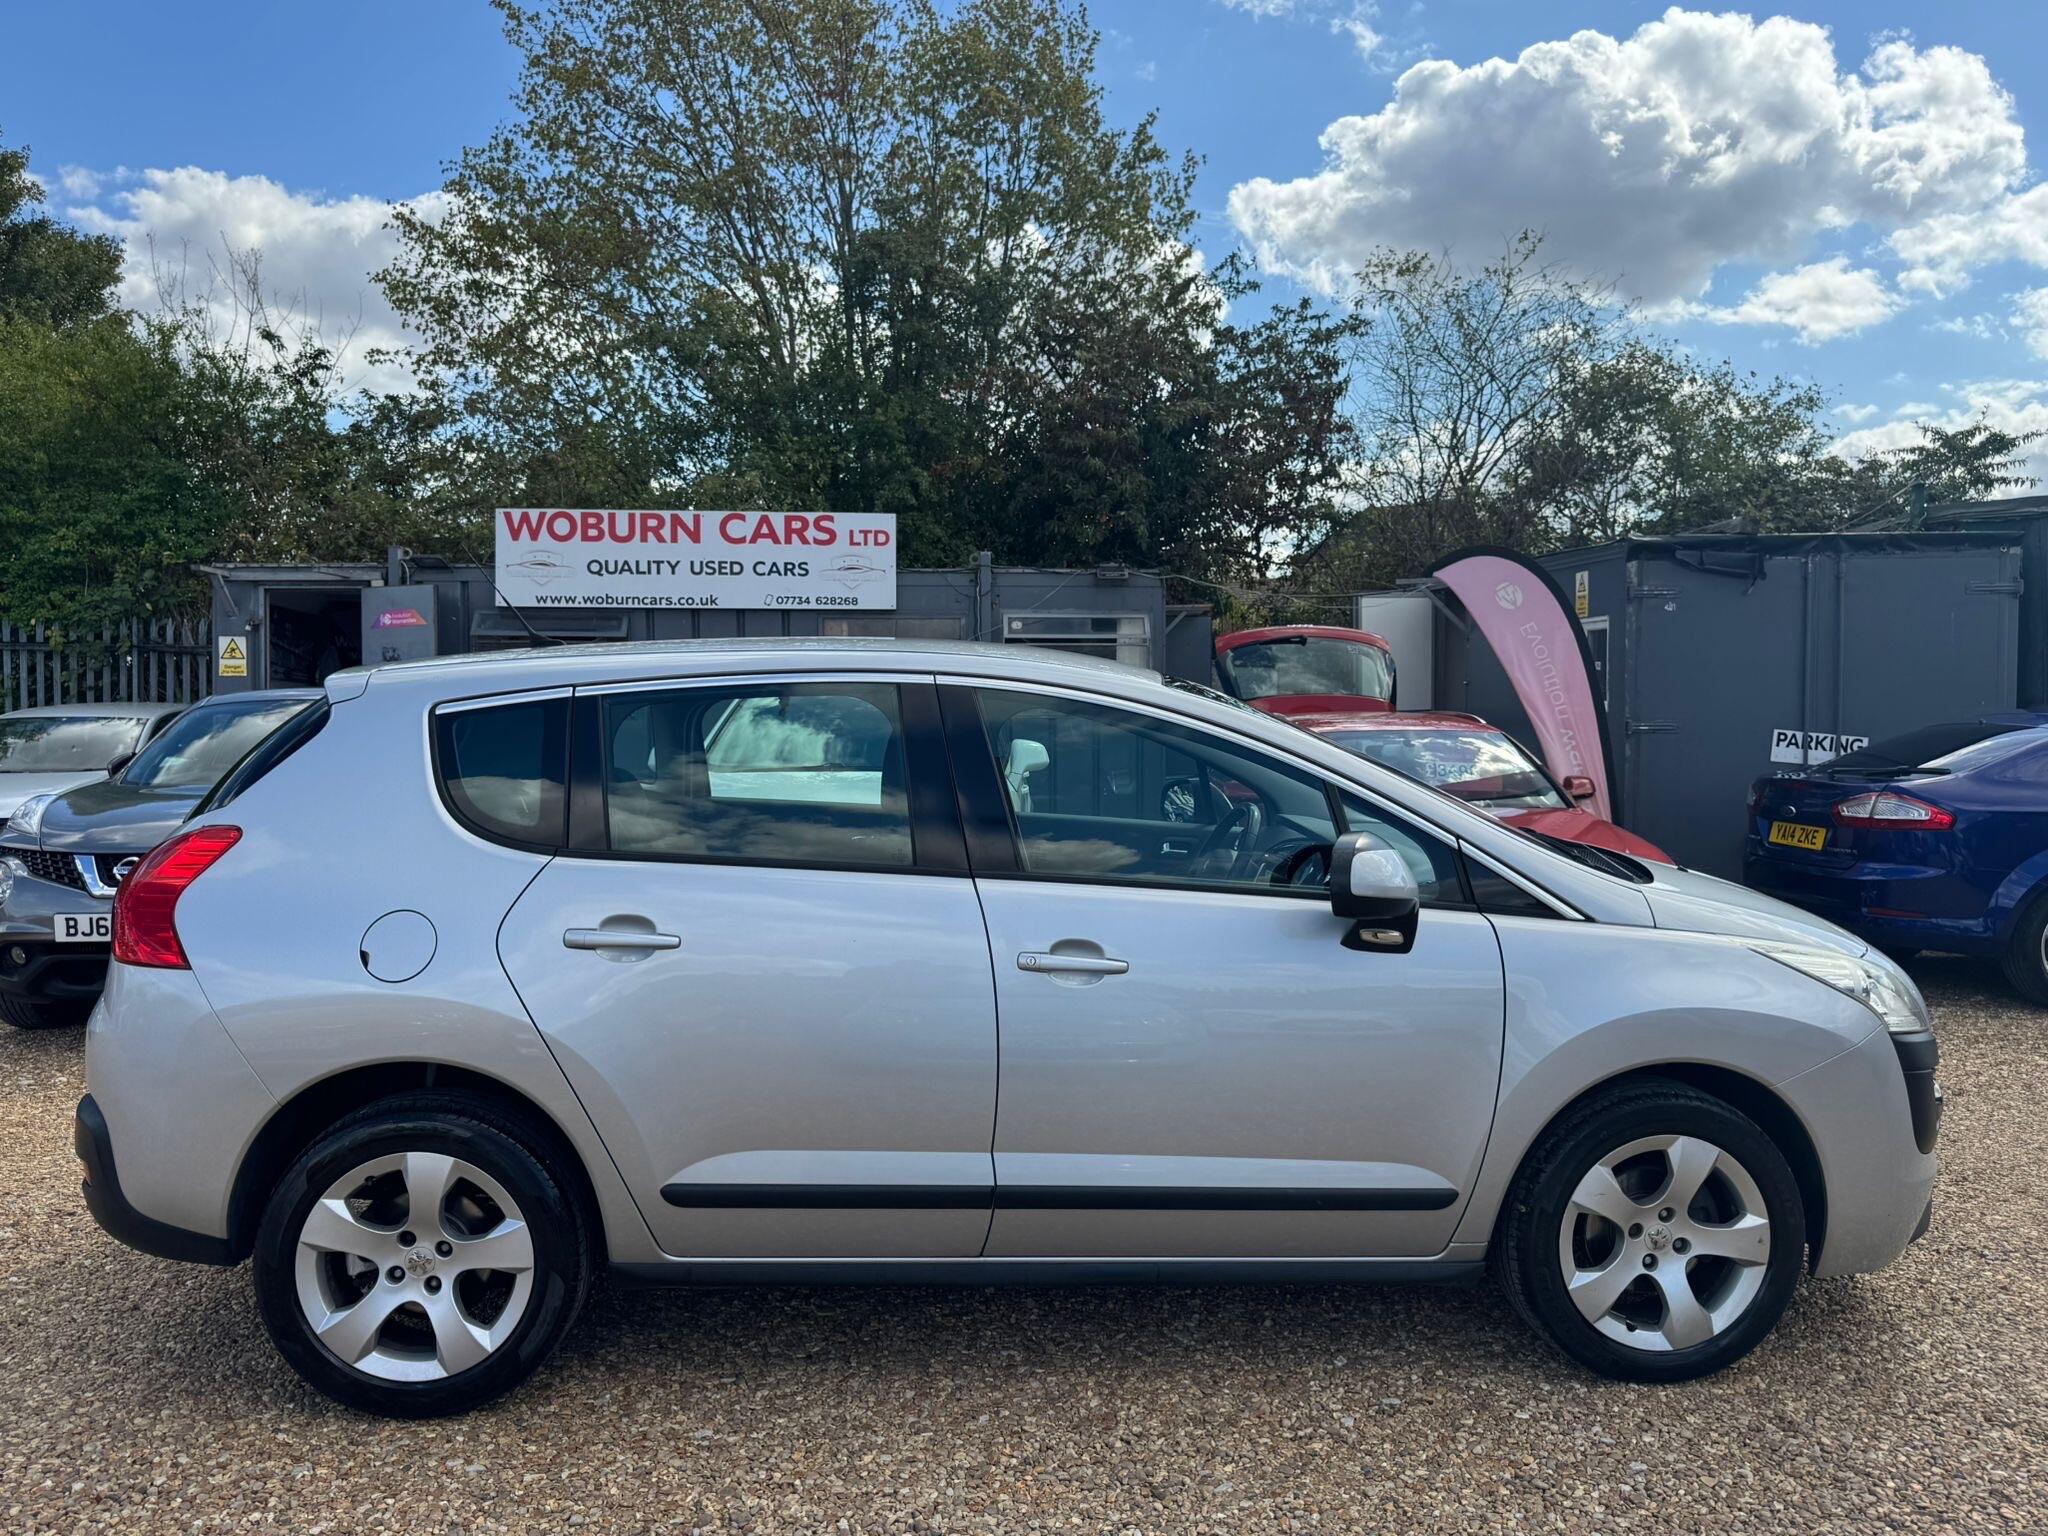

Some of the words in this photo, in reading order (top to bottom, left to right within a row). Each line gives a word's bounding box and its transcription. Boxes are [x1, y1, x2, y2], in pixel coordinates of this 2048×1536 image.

[503, 510, 701, 545] WOBURN
[718, 512, 838, 547] CARS
[848, 529, 891, 547] LTD
[586, 559, 681, 577] QUALITY
[689, 560, 744, 576] USED
[752, 561, 810, 577] CARS
[535, 593, 719, 607] www.woburncars.co.uk
[775, 595, 811, 606] 07734
[815, 596, 859, 607] 628268
[1775, 731, 1865, 754] PARKING
[1775, 824, 1797, 842] YA14
[1798, 828, 1820, 846] ZKE
[65, 917, 110, 937] BJ6
